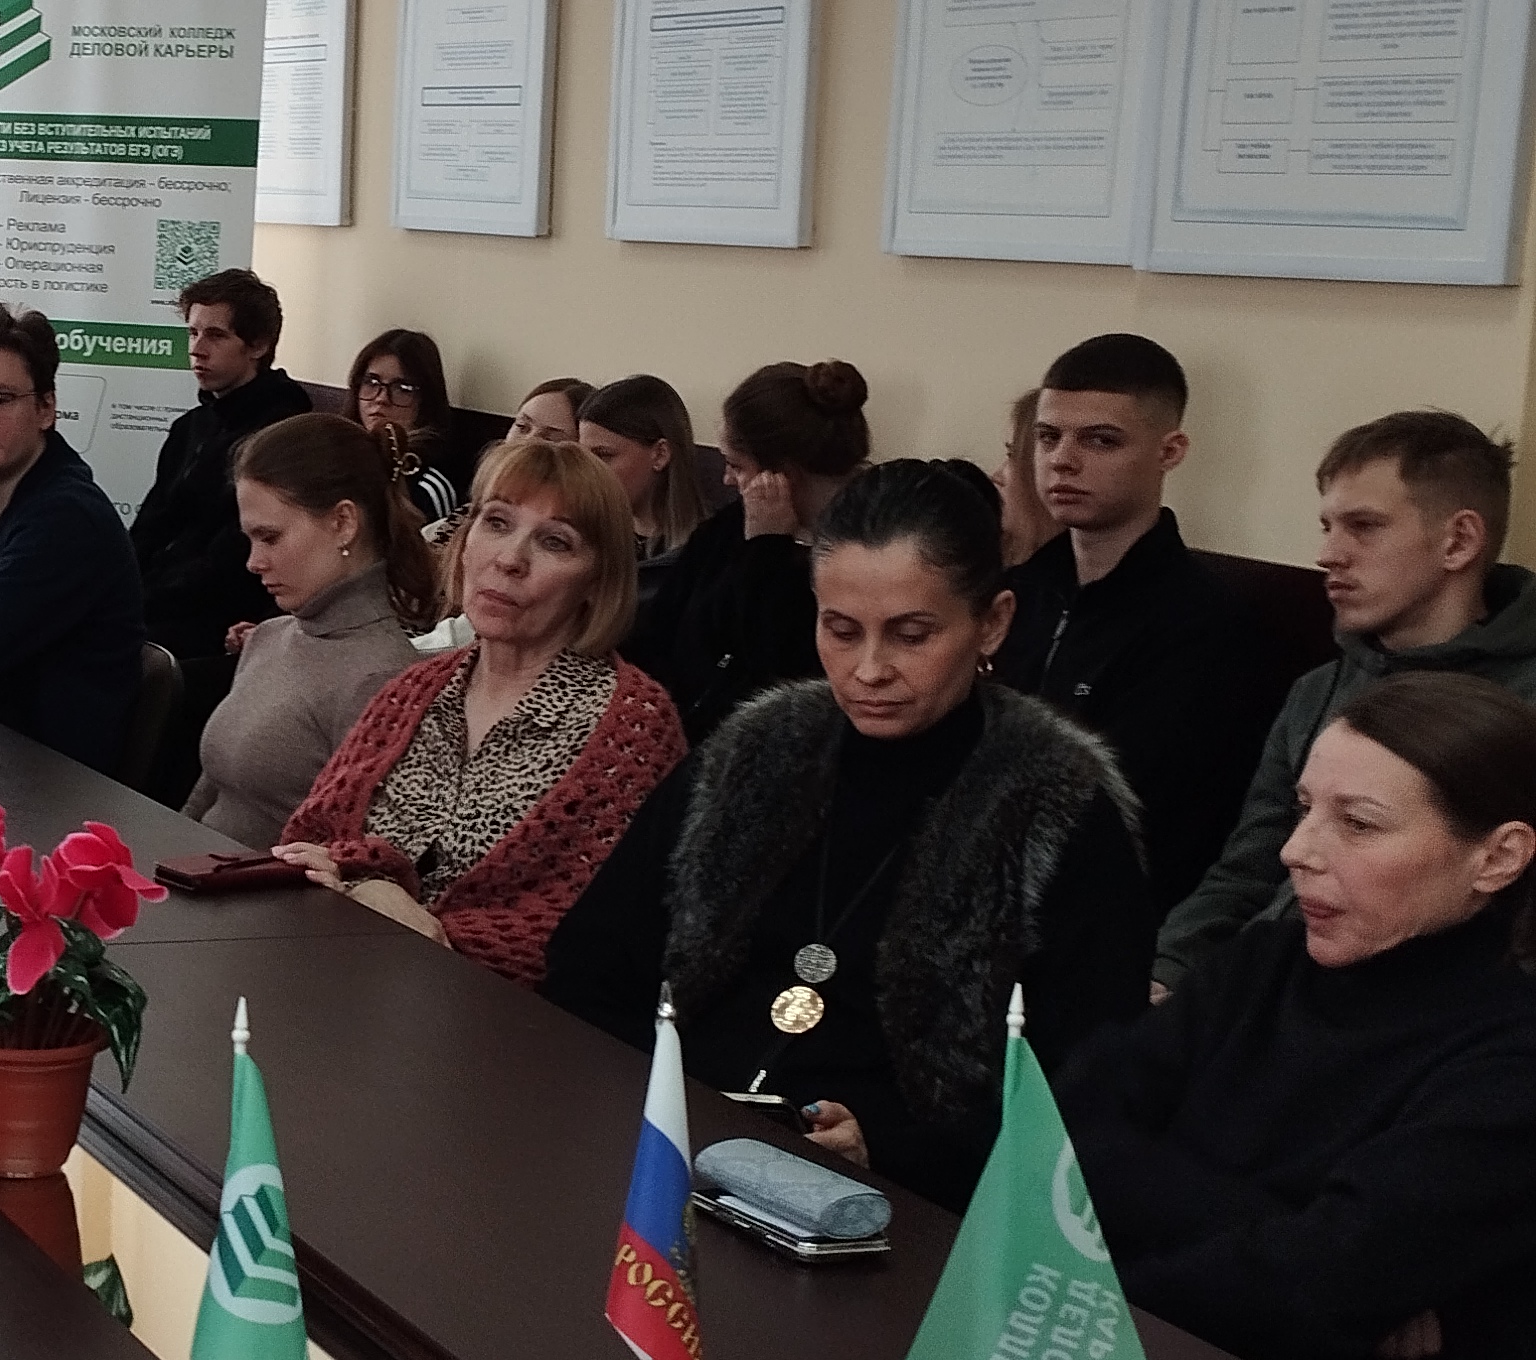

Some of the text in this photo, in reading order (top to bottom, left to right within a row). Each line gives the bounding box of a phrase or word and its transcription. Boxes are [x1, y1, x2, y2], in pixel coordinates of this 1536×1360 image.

[71, 24, 236, 40] МОСКОВСКИЙ КОЛЛЕДЖ
[69, 40, 234, 58] ДЕЛОВОЙ КАРЬЕРЫ
[14, 122, 36, 135] БЕЗ
[37, 123, 137, 138] ВСТУПИТЕЛЬНЫХ
[138, 125, 212, 140] ИСПЫТАНИЙ
[8, 140, 45, 154] УЧЕТА
[46, 141, 126, 156] РЕЗУЛЬТАТОВ
[128, 143, 151, 157] ЕГЭ
[152, 144, 184, 160] (ОГЭ)
[56, 176, 146, 189] аккредитация
[19, 190, 82, 206] Лицензия
[91, 192, 162, 209] бессрочно
[6, 218, 66, 233] Реклама
[5, 237, 116, 256] Юриспруденция
[4, 257, 104, 273] Операционная
[31, 280, 40, 289] в
[43, 280, 109, 293] логистике
[55, 328, 173, 356] обучения
